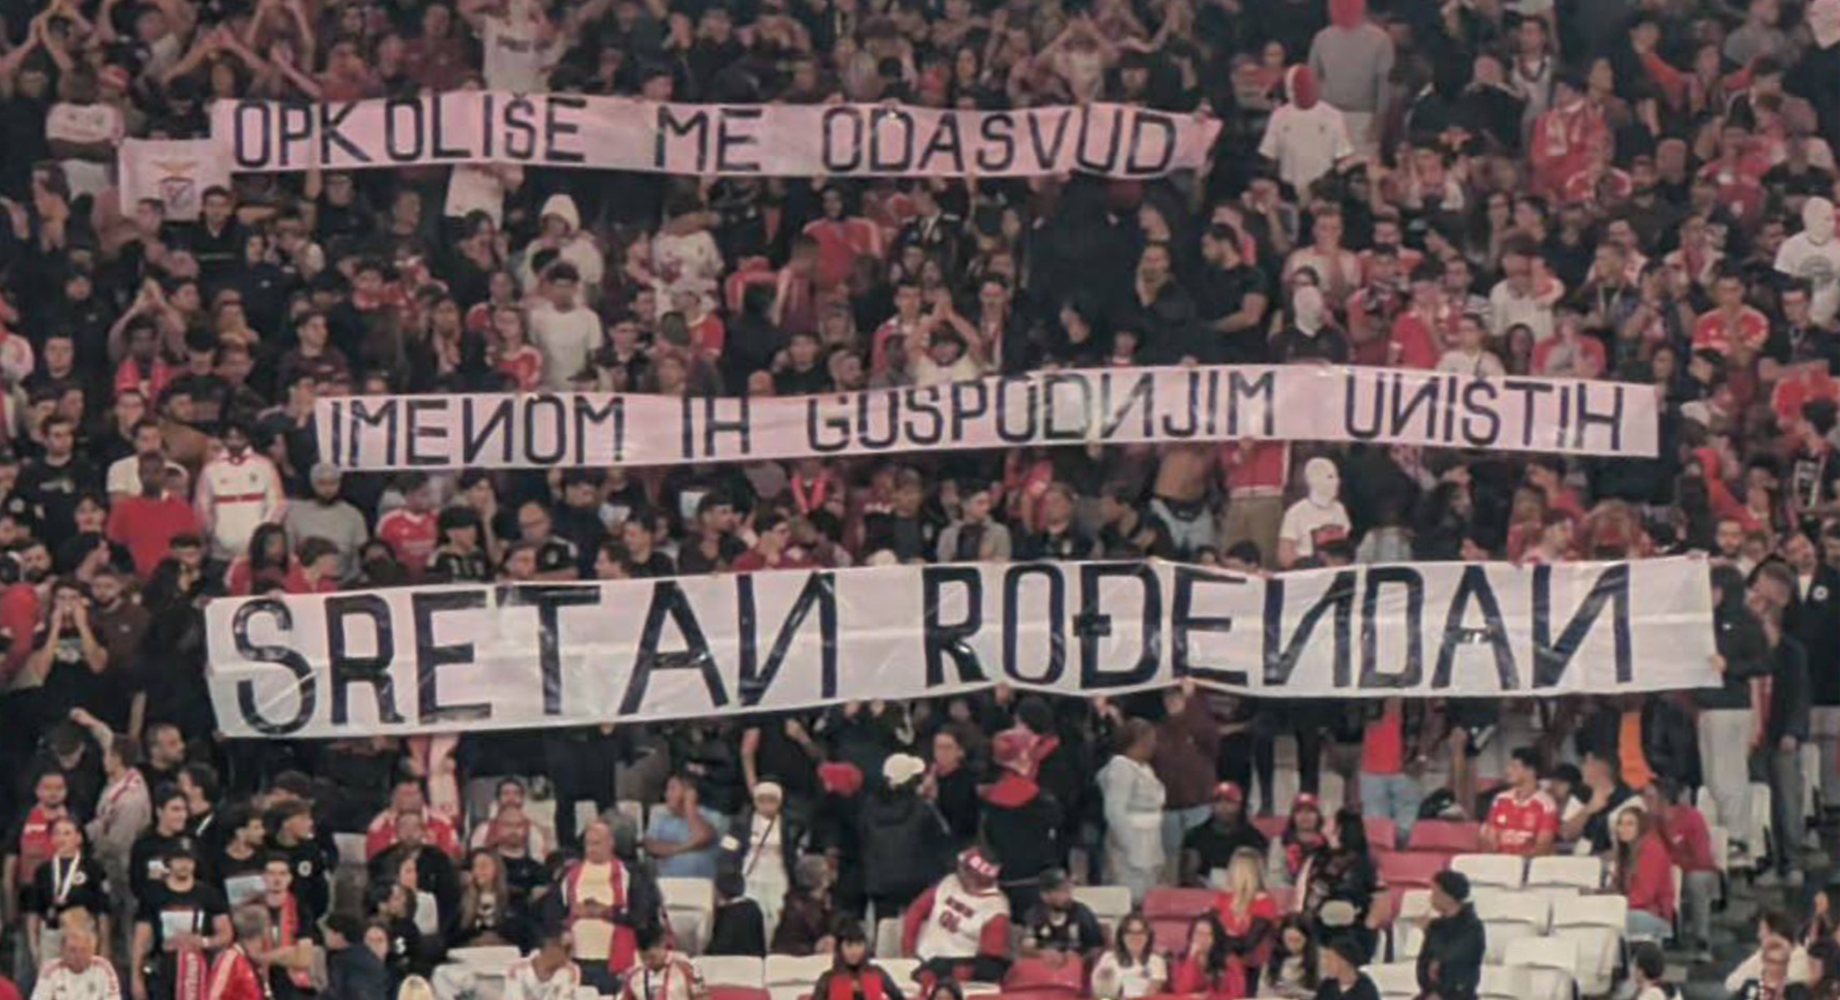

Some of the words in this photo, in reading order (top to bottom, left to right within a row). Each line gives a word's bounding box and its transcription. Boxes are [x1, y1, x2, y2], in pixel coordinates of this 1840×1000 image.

[233, 91, 586, 168] OPKOLIŠE
[654, 105, 762, 172] ME
[822, 104, 1177, 175] ODASVUD
[331, 394, 624, 466] IMENOM
[681, 398, 750, 460] IH
[232, 571, 835, 735] SRETAN
[923, 563, 1632, 690] ROĐENDAN
